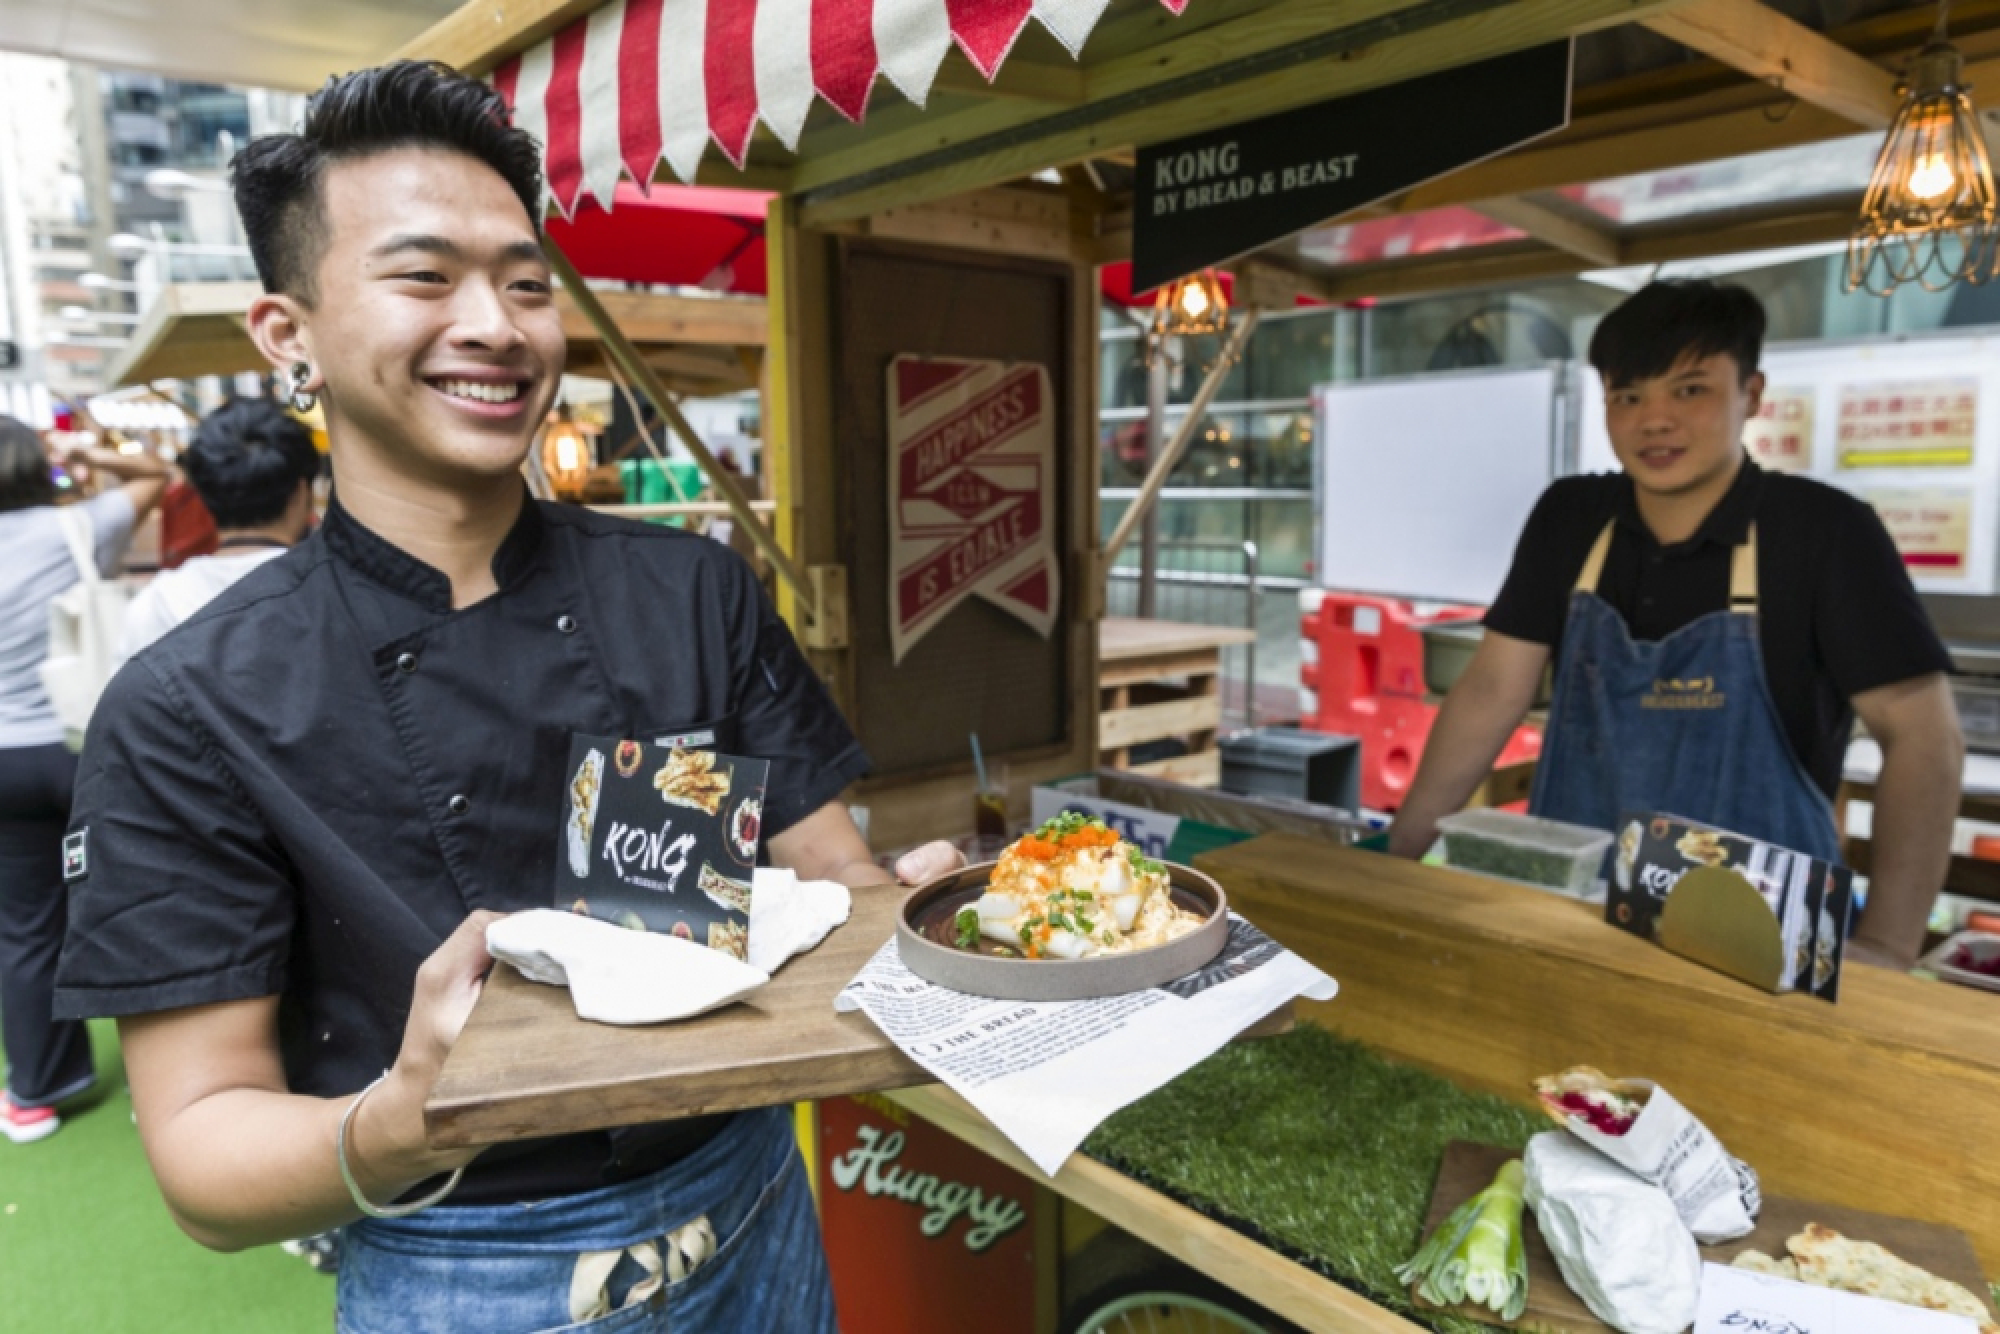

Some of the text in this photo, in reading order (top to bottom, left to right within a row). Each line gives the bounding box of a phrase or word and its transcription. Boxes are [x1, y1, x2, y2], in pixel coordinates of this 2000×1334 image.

[1153, 153, 1359, 216] BY BREAD & BEAST
[1155, 141, 1239, 189] KONG
[916, 385, 1024, 482] HAPPINESS
[918, 508, 1023, 605] IS EDIBLE
[602, 819, 697, 894] KONG
[831, 1123, 1026, 1250] Hungry
